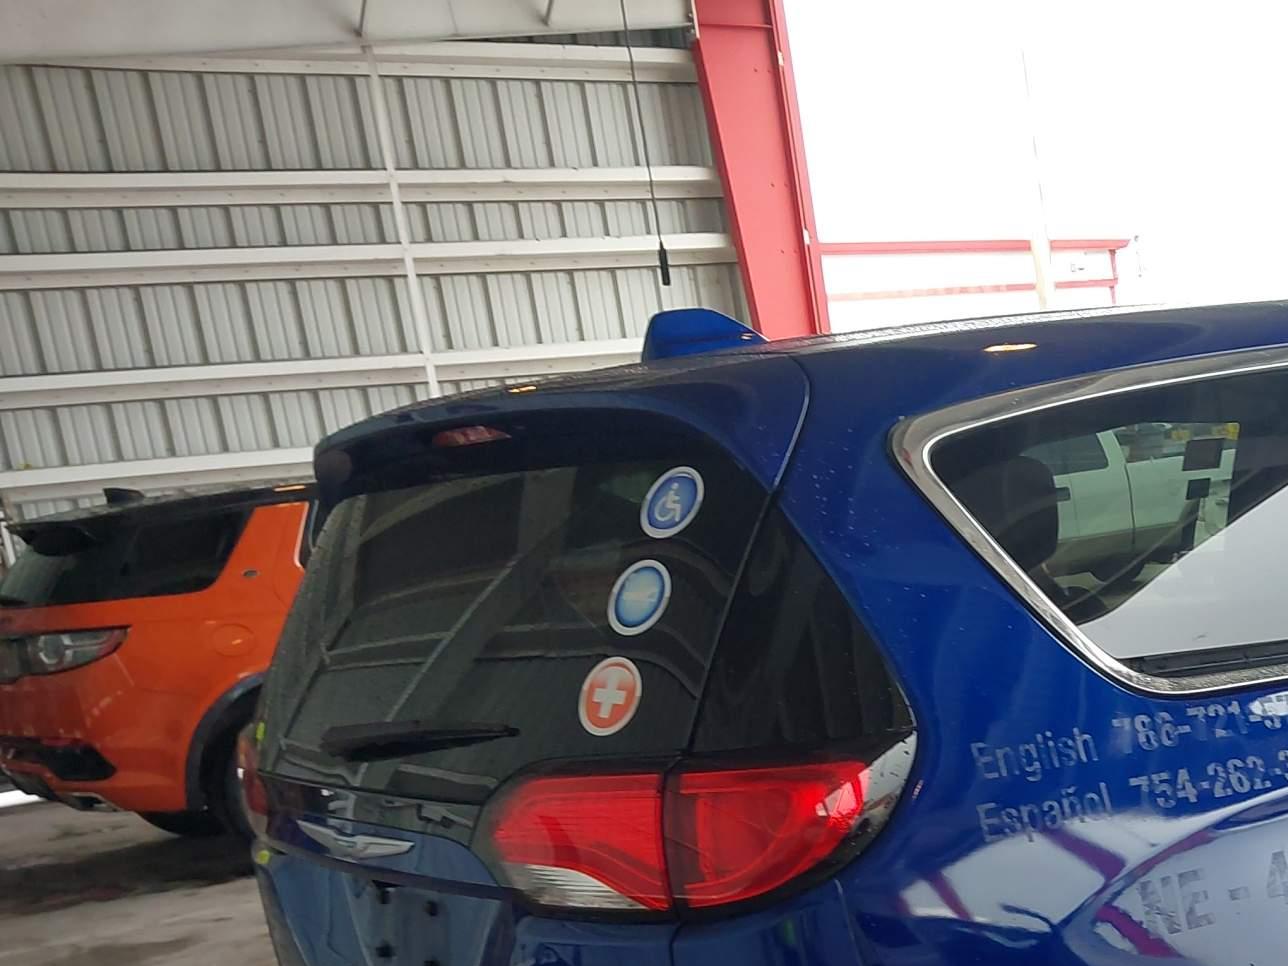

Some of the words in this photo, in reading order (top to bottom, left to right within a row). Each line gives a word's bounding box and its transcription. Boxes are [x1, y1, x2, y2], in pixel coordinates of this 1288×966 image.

[970, 726, 1100, 782] English
[975, 781, 1113, 842] Español
[1138, 869, 1215, 935] NE
